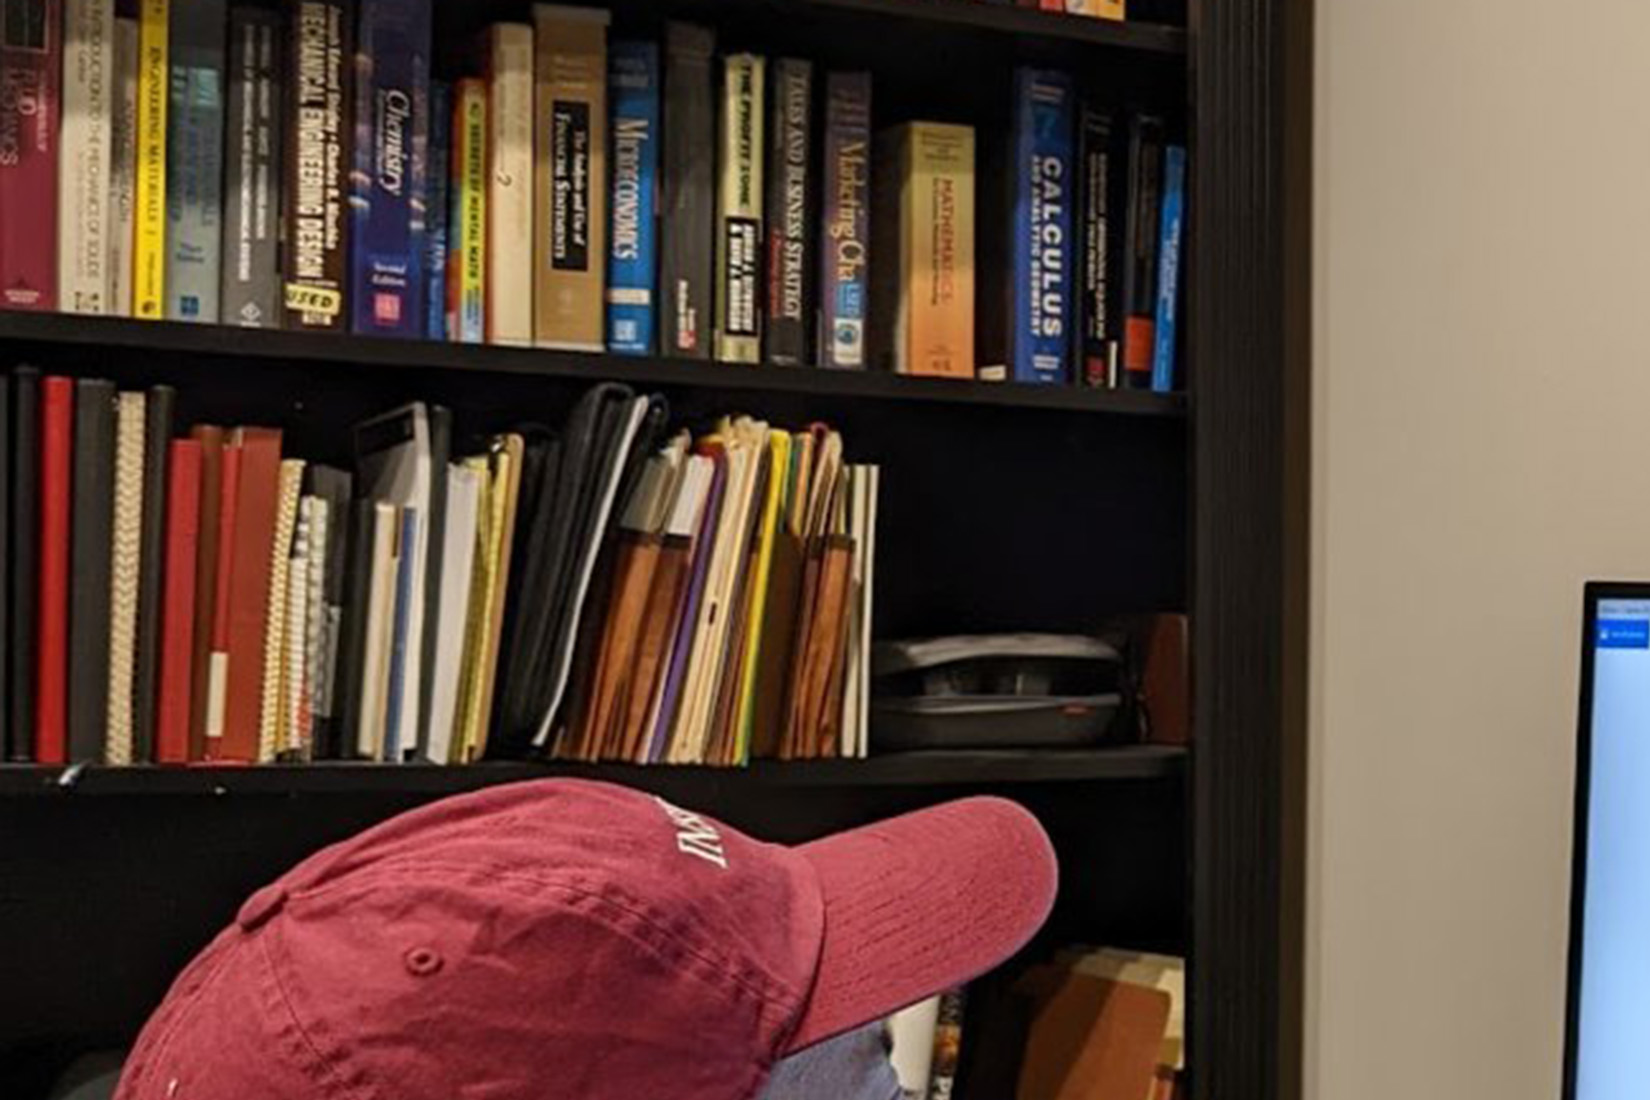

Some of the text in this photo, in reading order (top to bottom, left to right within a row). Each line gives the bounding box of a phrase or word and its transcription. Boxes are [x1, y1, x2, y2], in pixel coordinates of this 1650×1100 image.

[149, 46, 162, 138] ENGINEERING
[300, 3, 326, 103] MECHANICAL
[147, 145, 161, 222] MATERIALS
[298, 107, 325, 214] ENGINEERING
[379, 89, 412, 196] Chemistry
[469, 124, 481, 174] SECRETS
[739, 64, 753, 208] THE PROFIT ZONE
[786, 127, 806, 163] AND
[468, 196, 481, 241] MENTAL
[553, 111, 572, 259] FINANCIAL STATEMENTS
[612, 118, 650, 260] MICROECONOMICS
[784, 165, 806, 238] BUSINESS
[829, 140, 867, 282] Marketing Cha
[297, 218, 324, 277] DESIGN
[467, 245, 480, 279] MATH
[783, 240, 804, 321] STRATEGY
[939, 179, 955, 303] MATHEMATICS
[1030, 155, 1041, 338] AND ANALYTIC GEOMETRY
[1041, 156, 1064, 337] CALCULUS
[287, 290, 333, 308] USED
